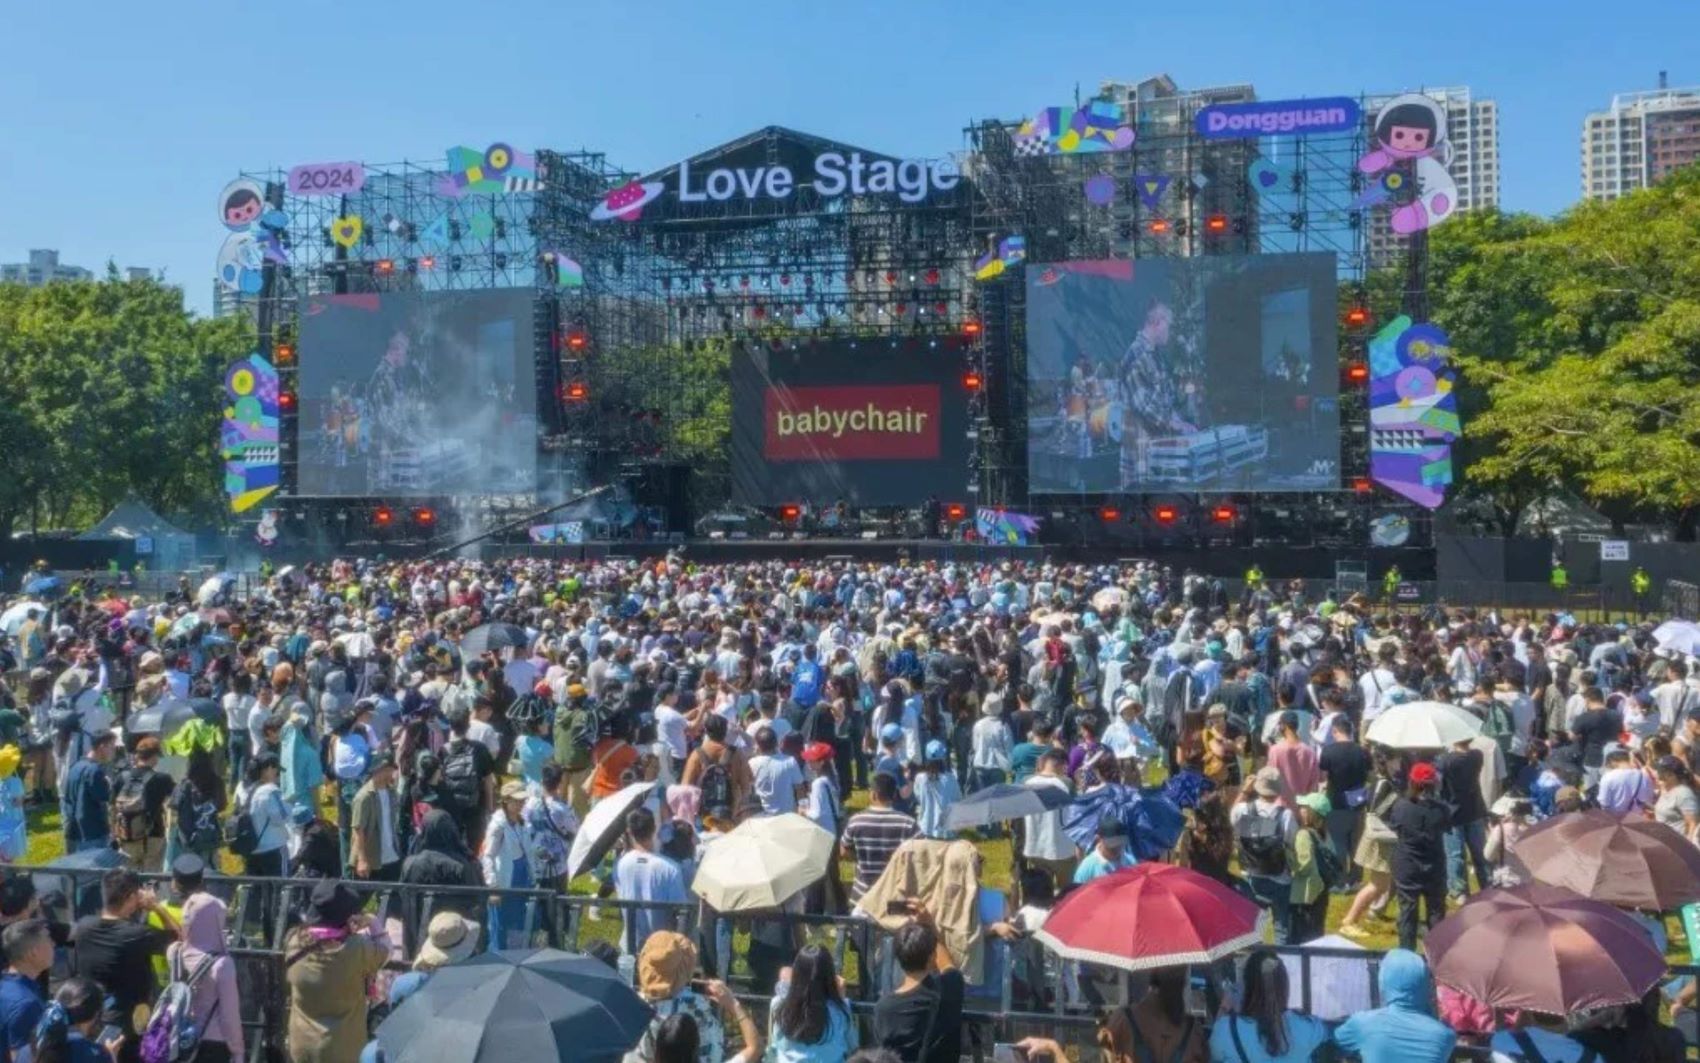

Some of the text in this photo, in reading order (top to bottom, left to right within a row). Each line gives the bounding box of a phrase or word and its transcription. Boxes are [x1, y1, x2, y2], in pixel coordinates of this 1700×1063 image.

[1208, 107, 1346, 132] Dongguan
[299, 169, 354, 190] 2024
[679, 151, 959, 201] Love Stage
[777, 403, 927, 438] babychair
